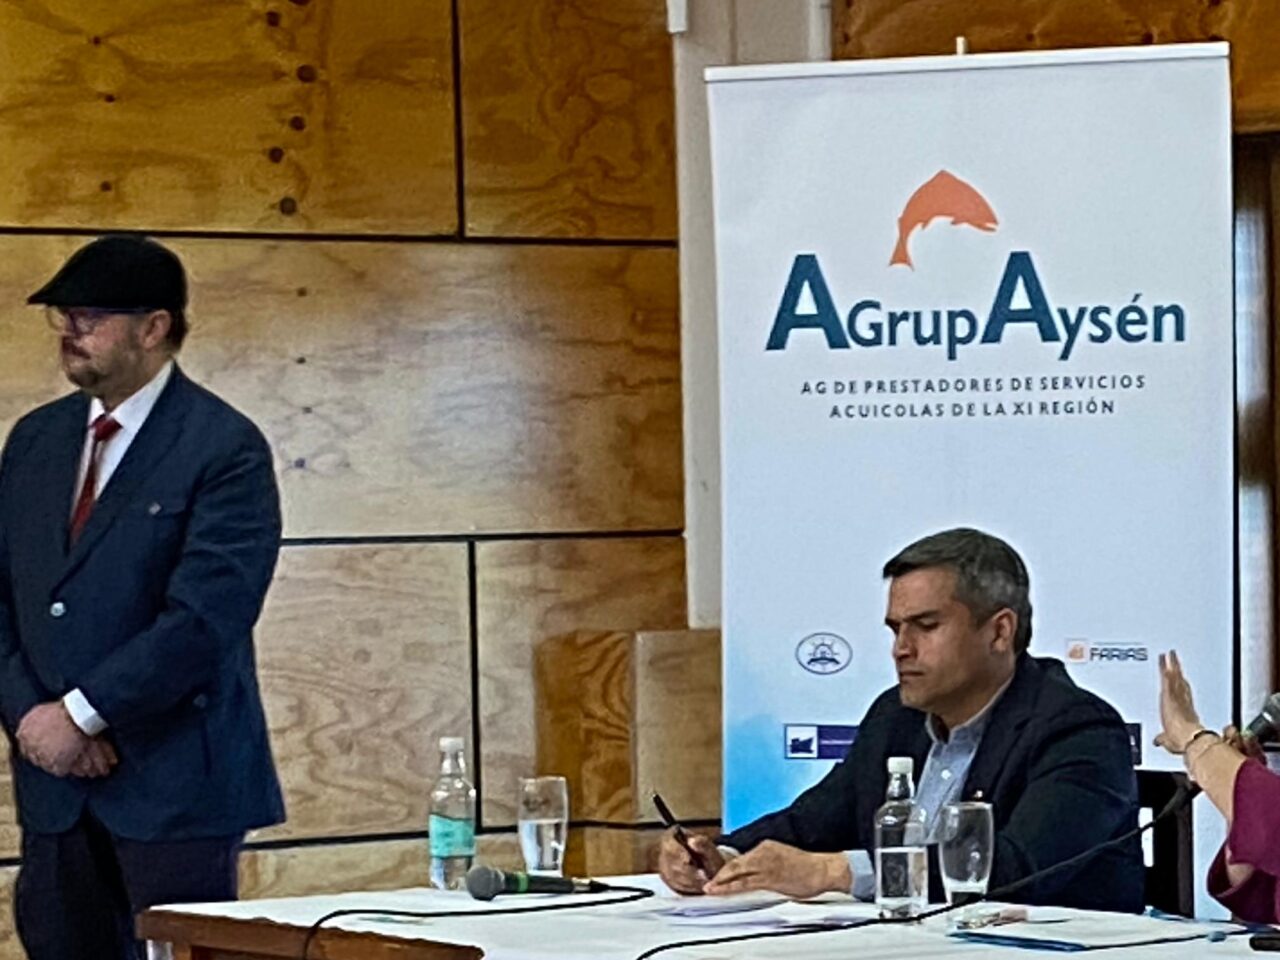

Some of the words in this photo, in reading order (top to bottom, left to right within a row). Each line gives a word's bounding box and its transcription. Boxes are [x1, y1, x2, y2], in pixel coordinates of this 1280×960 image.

[765, 251, 1185, 361] AGrupAysén
[801, 381, 827, 395] AG
[834, 381, 857, 394] DE
[864, 378, 1003, 394] PRESTADORES
[1011, 377, 1032, 391] DE
[1040, 374, 1146, 390] SERVICIOS
[829, 403, 944, 418] ACUICOLAS
[952, 402, 976, 417] DE
[983, 402, 1006, 416] LA
[1012, 402, 1032, 415] XI
[1039, 397, 1114, 415] REGIÓN
